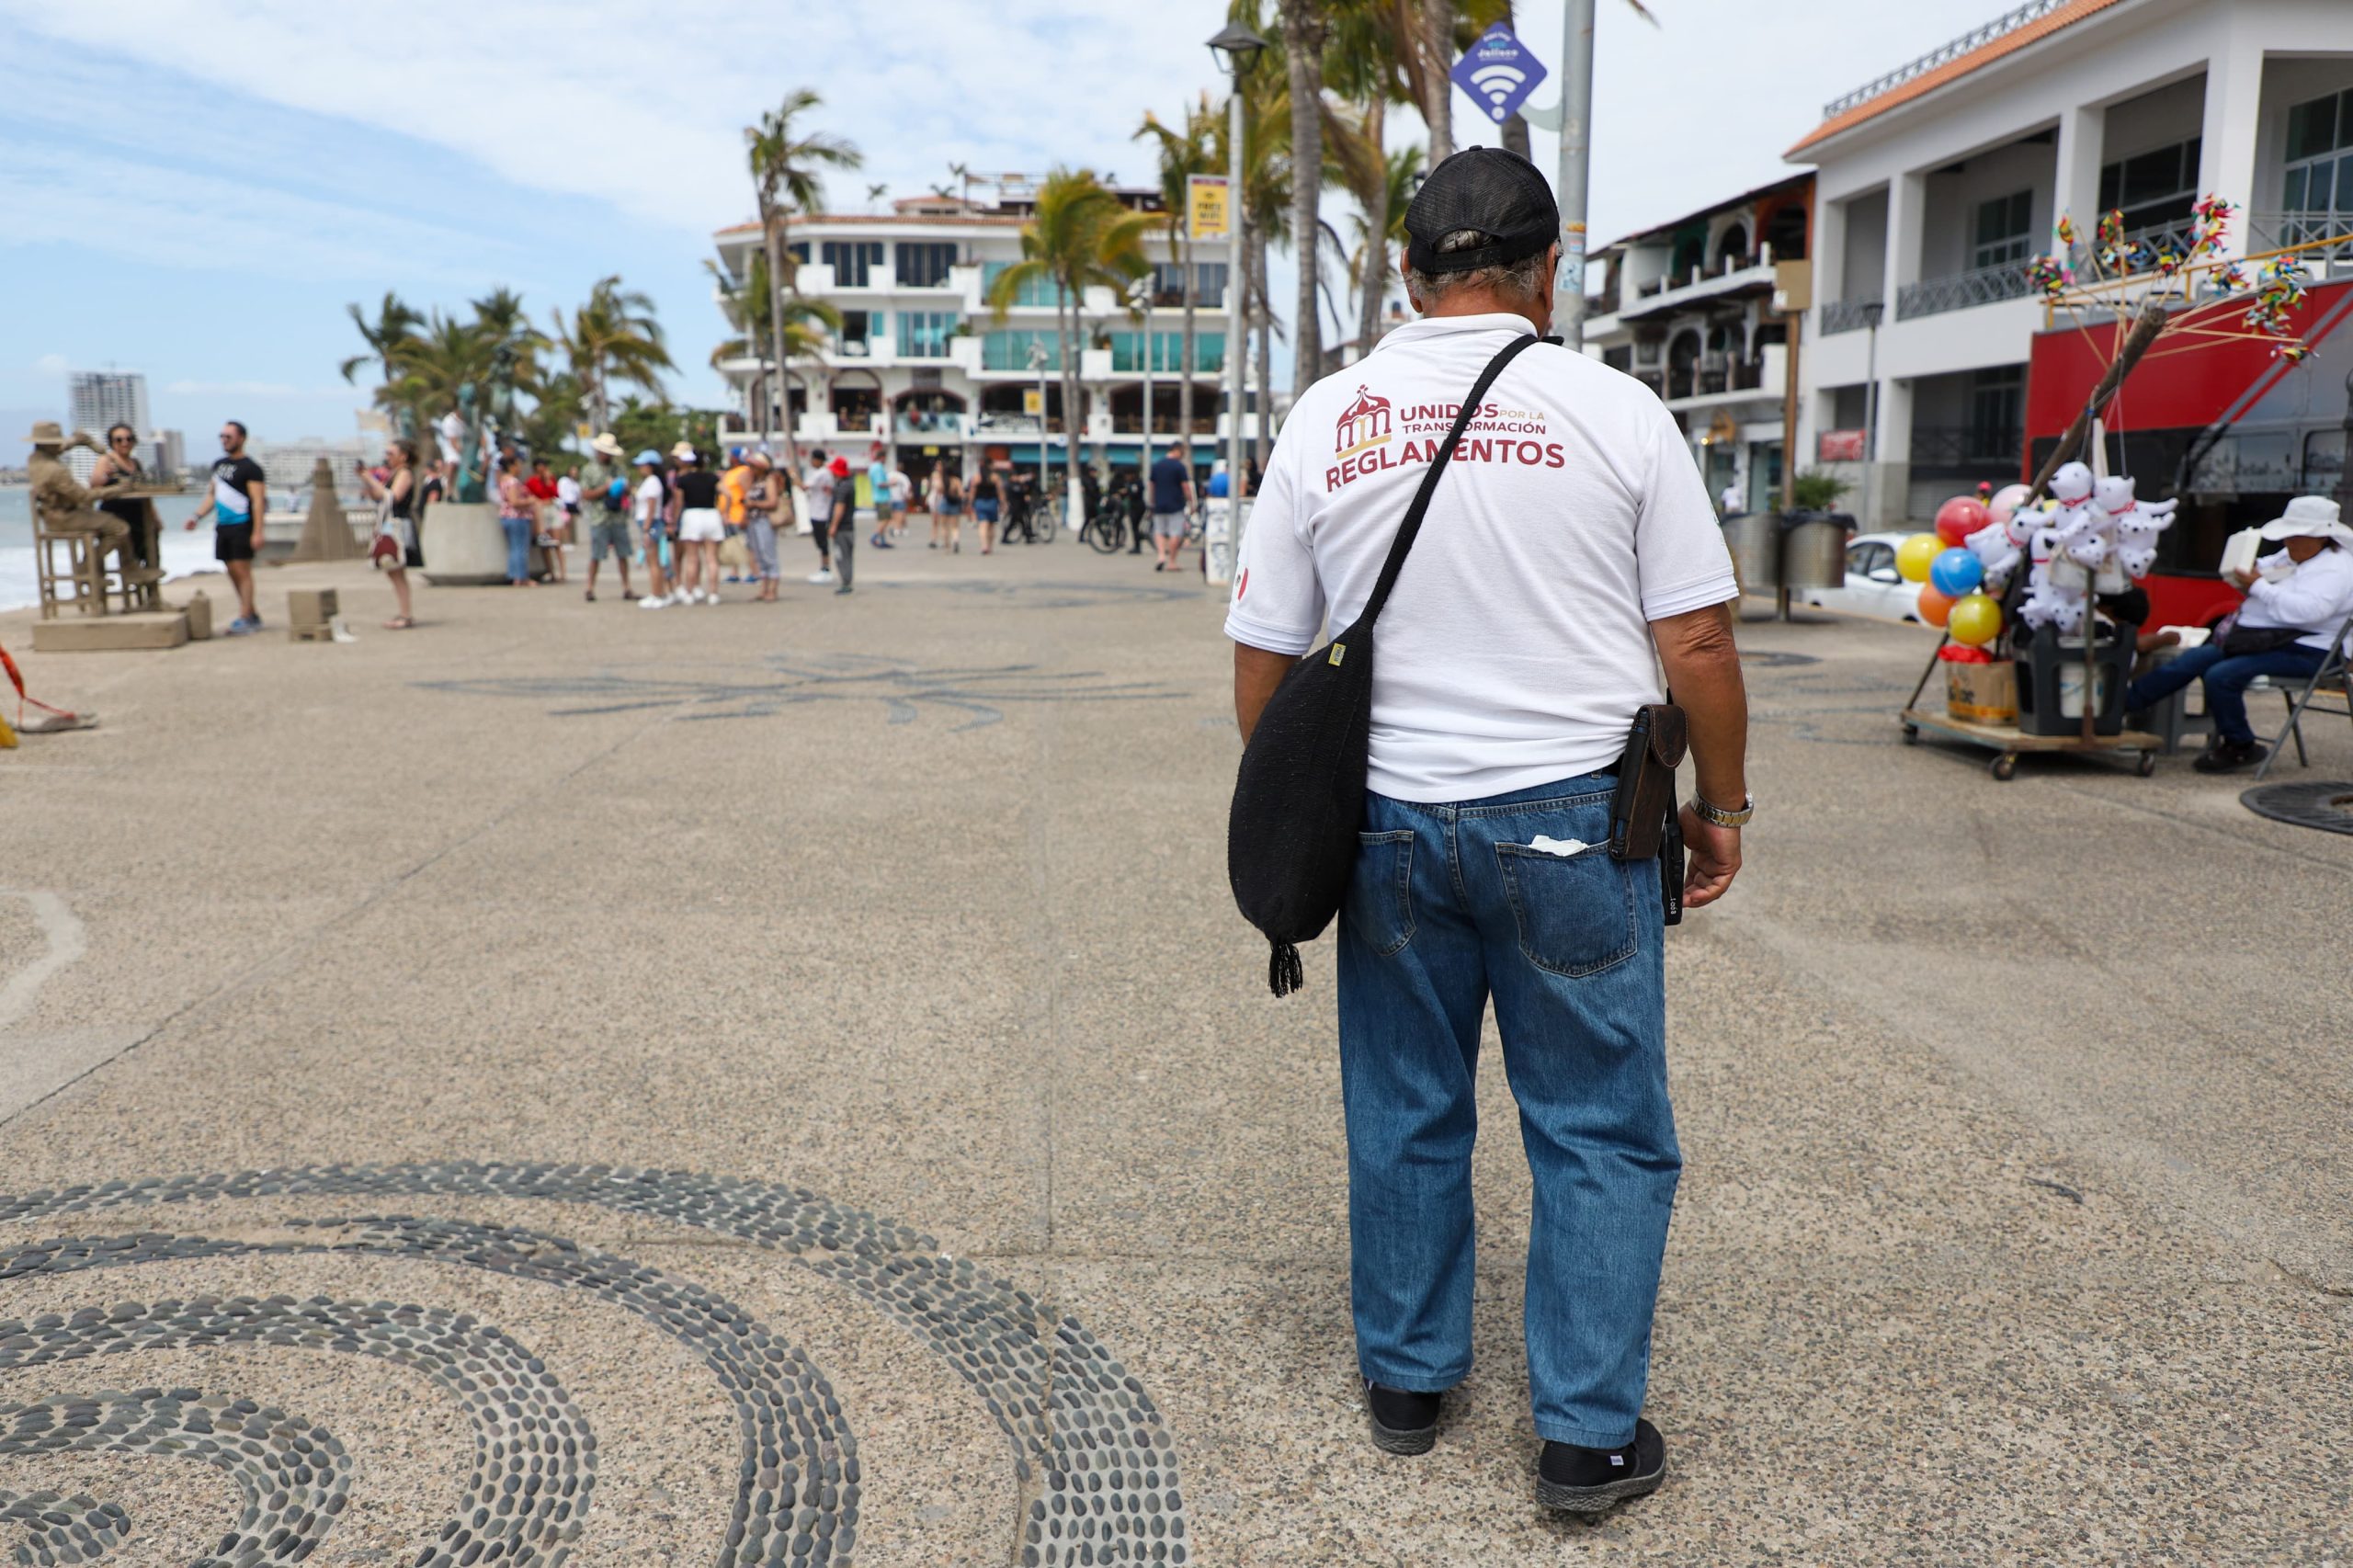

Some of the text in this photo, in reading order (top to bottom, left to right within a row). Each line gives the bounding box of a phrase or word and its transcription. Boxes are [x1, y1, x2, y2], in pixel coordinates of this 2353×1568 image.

[1198, 201, 1222, 210] FREE
[1499, 410, 1526, 419] POR
[1529, 411, 1545, 421] LA
[1402, 421, 1546, 435] TRANSORMACIÓN
